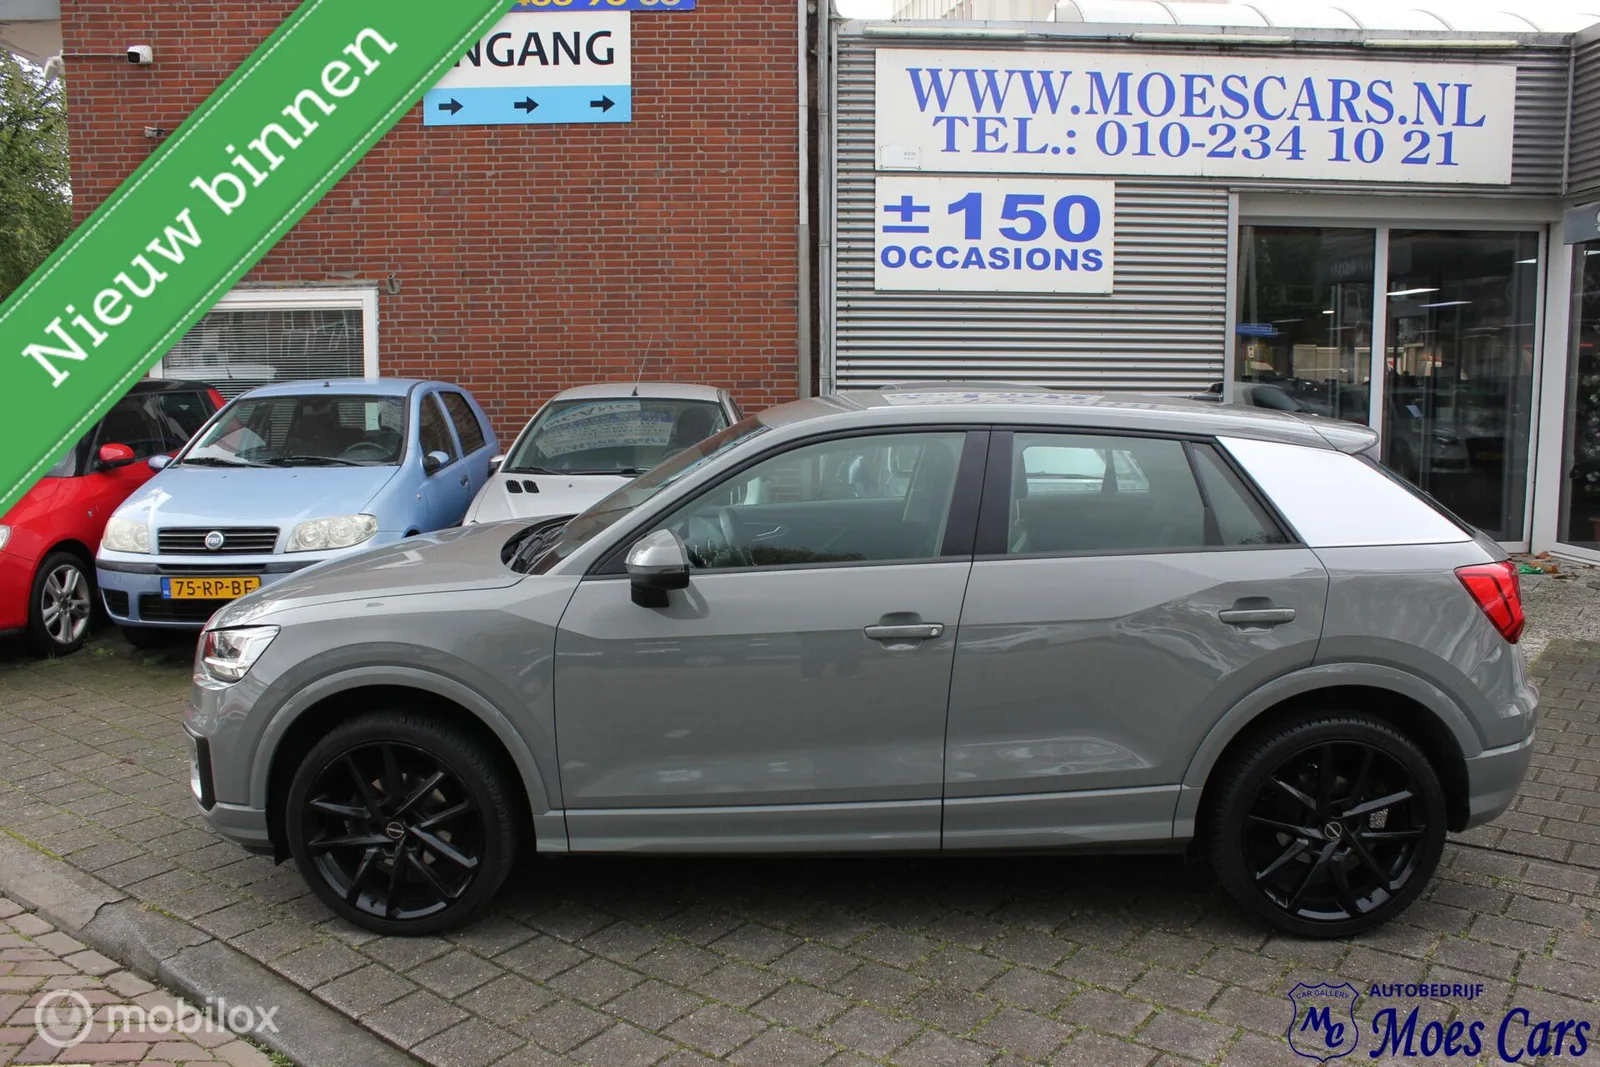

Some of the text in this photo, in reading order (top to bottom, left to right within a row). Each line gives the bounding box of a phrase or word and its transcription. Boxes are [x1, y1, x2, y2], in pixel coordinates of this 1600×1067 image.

[905, 67, 1487, 128] WWW.MOESCARS.NL
[932, 115, 1460, 167] TEL.: 010-234 10 21
[947, 191, 1102, 243] 150
[880, 244, 1104, 272] OCCASIONS
